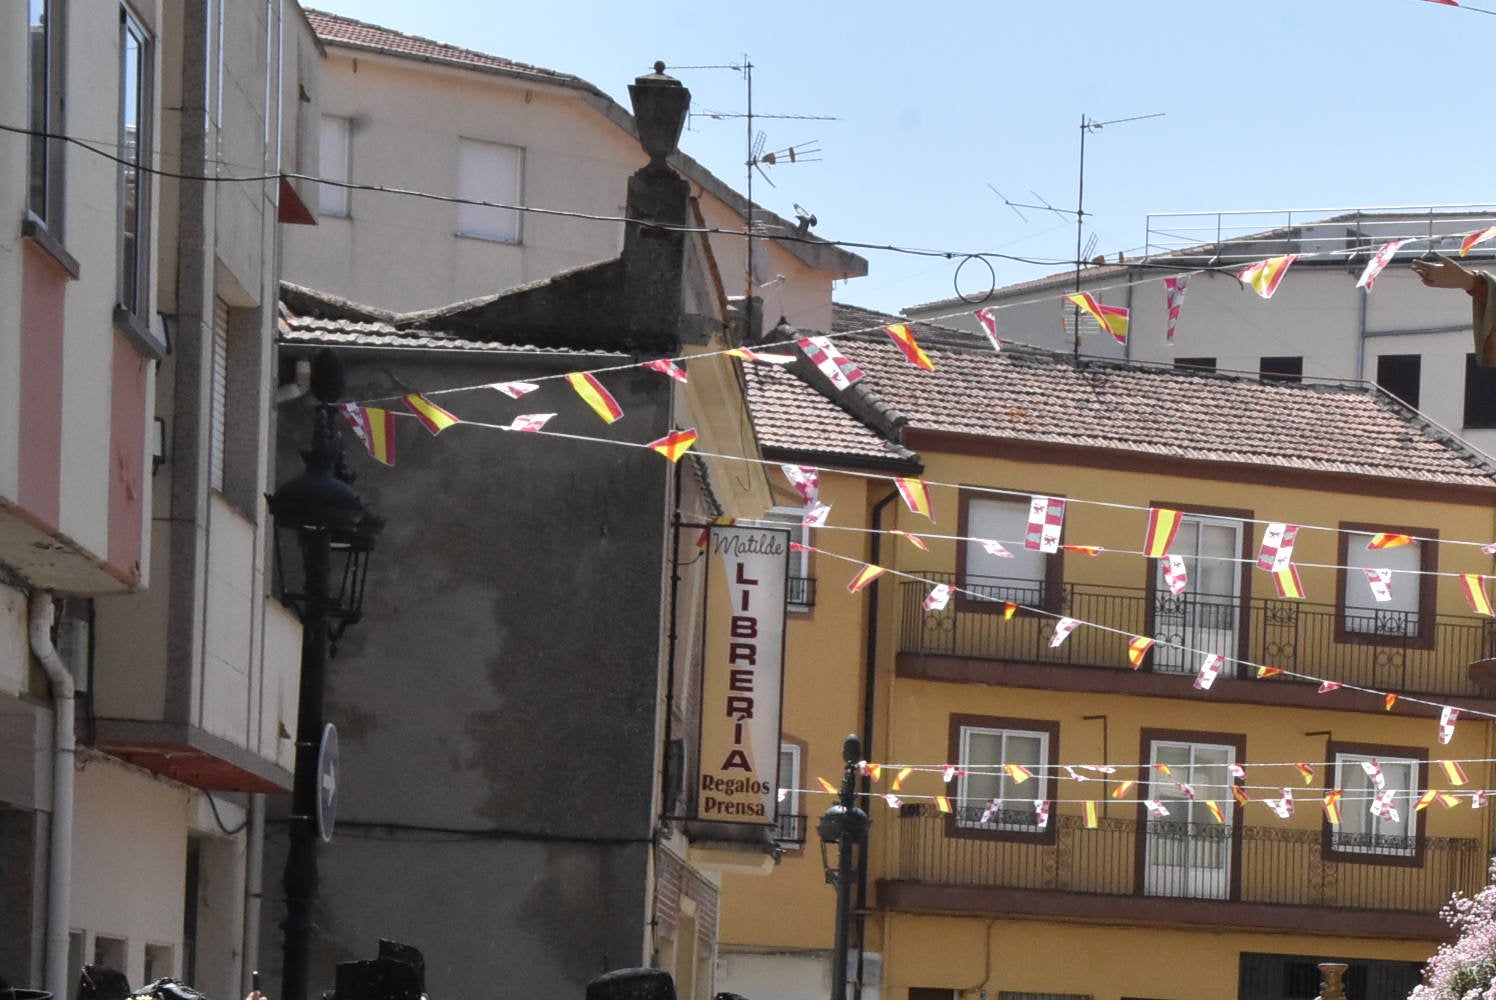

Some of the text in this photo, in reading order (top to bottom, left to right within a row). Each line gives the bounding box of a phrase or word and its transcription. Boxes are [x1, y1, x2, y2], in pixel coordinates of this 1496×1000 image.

[713, 533, 784, 557] Matilde
[720, 562, 759, 772] LIBRERÍA
[702, 774, 770, 796] Regalos
[704, 797, 765, 816] Prensa
